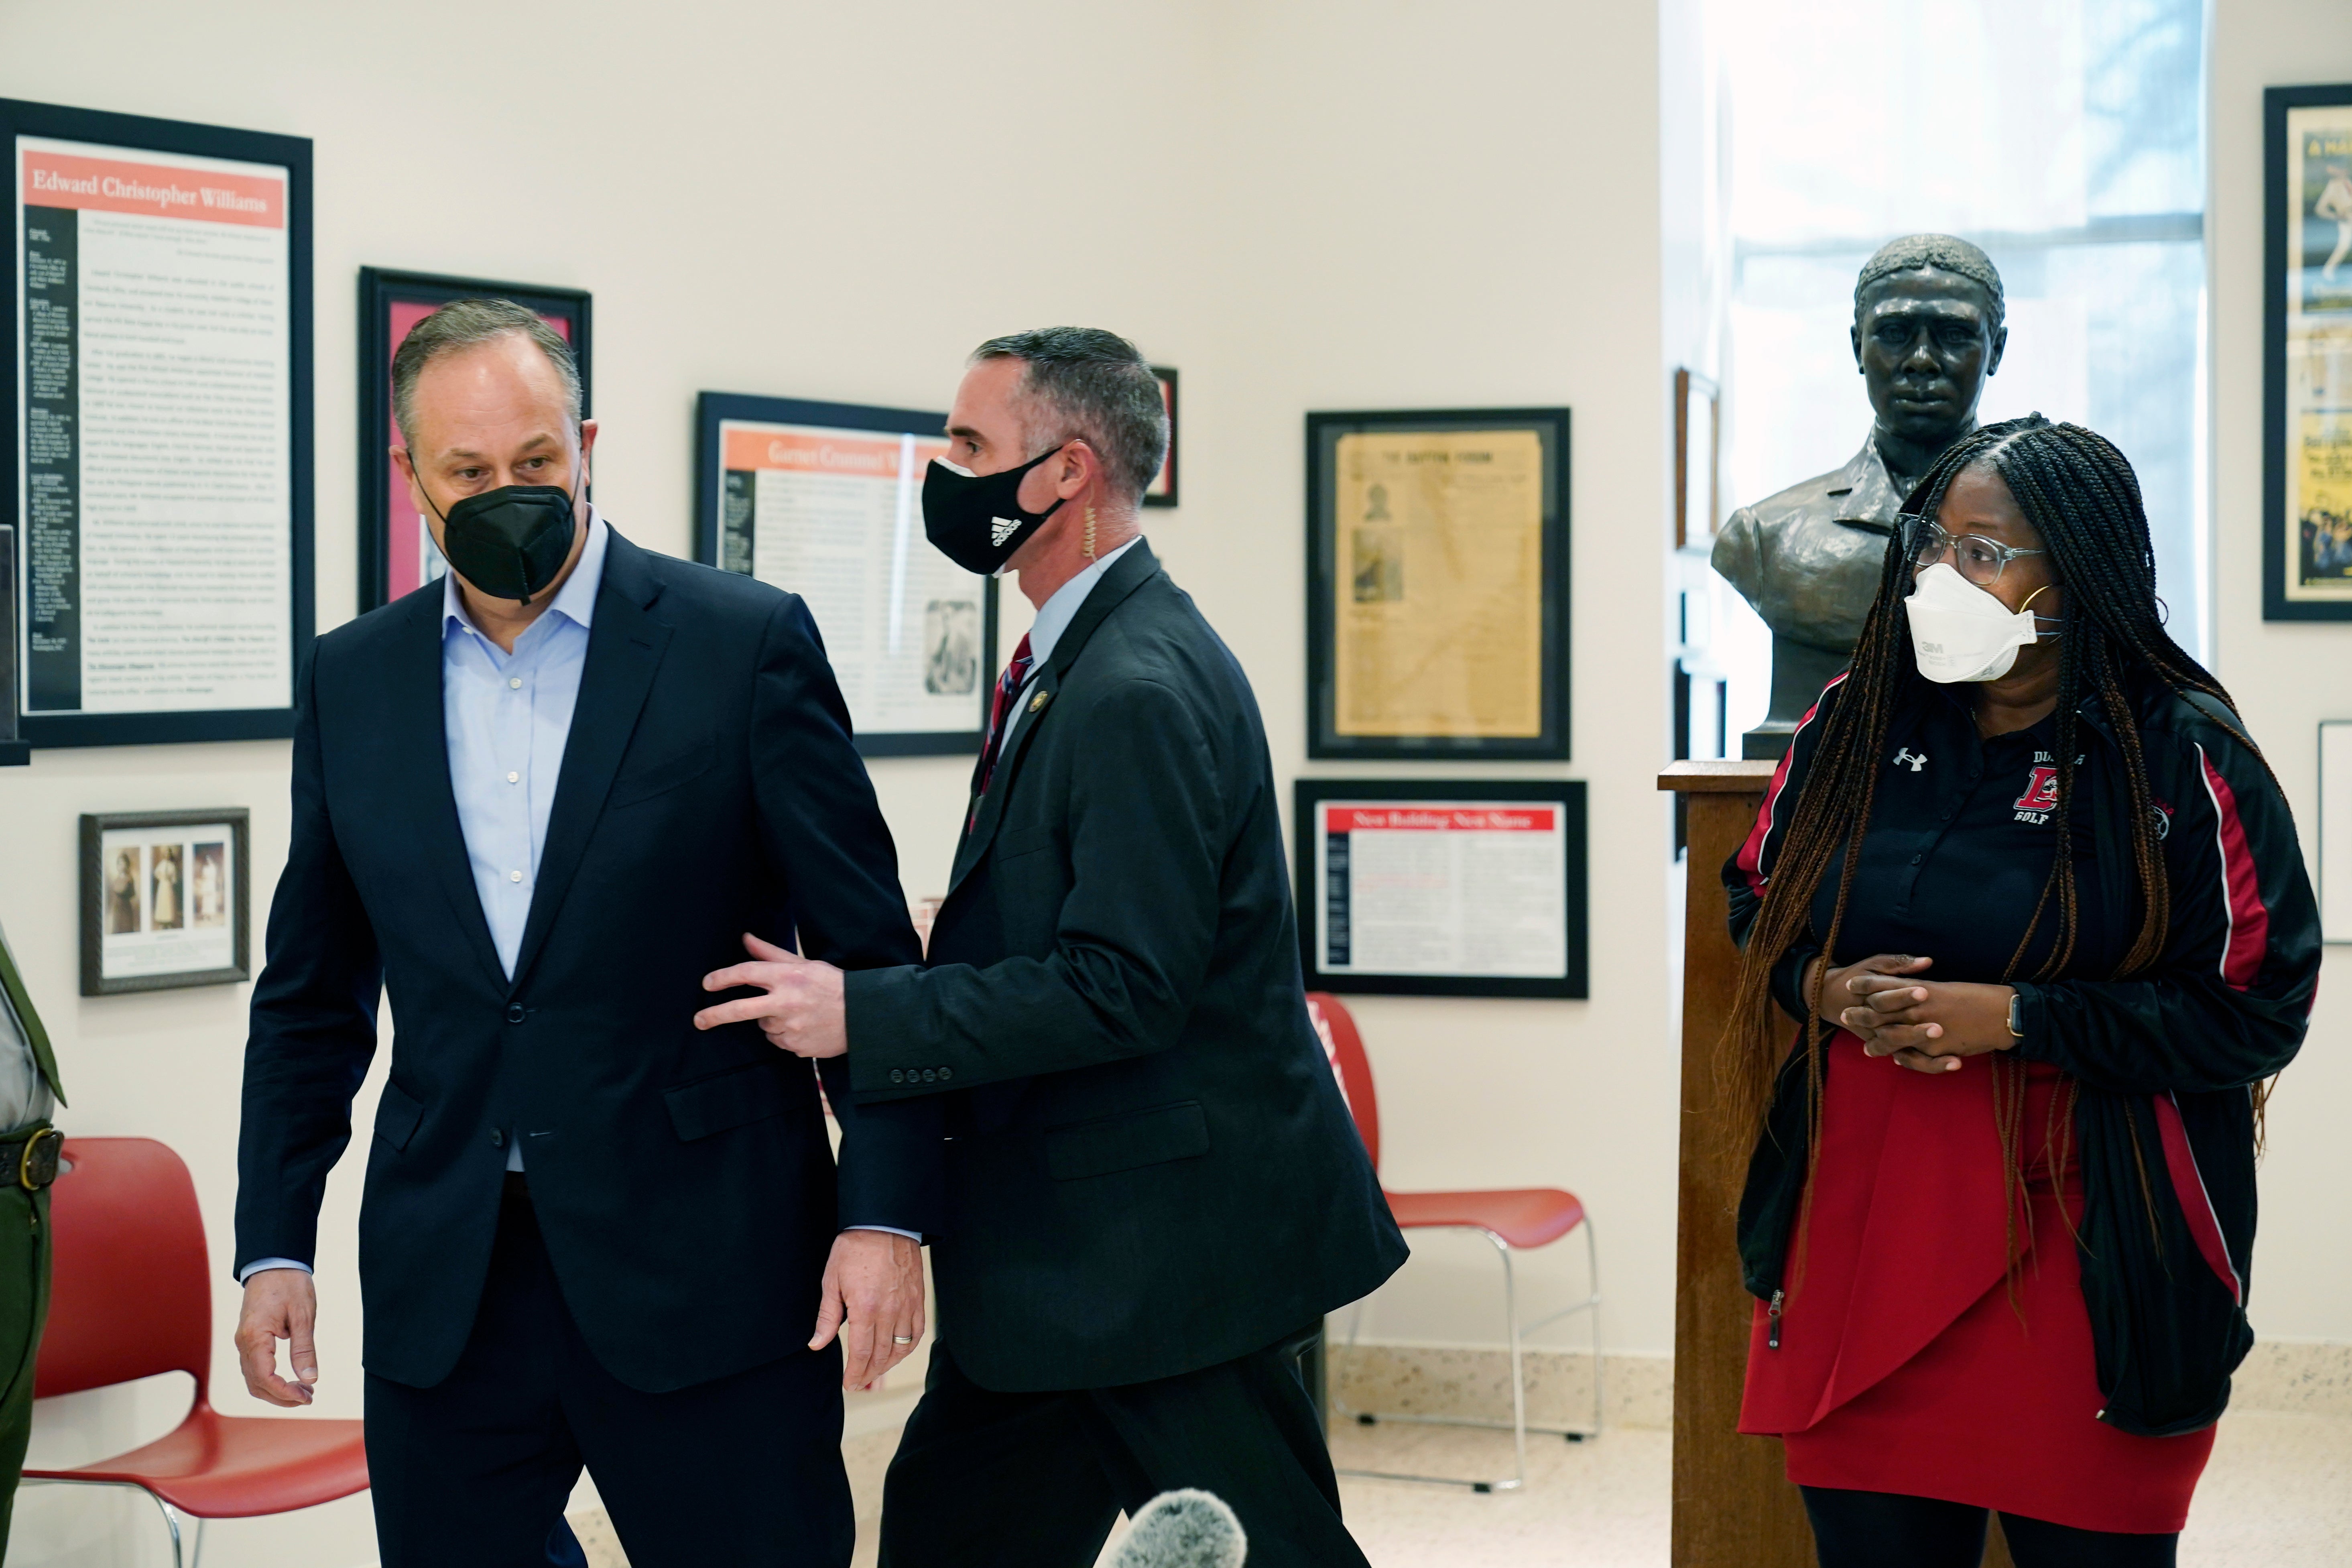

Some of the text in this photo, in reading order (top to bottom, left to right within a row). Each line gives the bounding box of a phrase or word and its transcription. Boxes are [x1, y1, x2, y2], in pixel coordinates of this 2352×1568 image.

[32, 169, 267, 213] Edward Christopher Williams
[992, 519, 1022, 547] adidas
[1922, 641, 1943, 654] 3M
[1353, 810, 1386, 828] New
[1453, 811, 1485, 828] New
[1488, 811, 1533, 828] Name
[2014, 811, 2049, 824] GOLF
